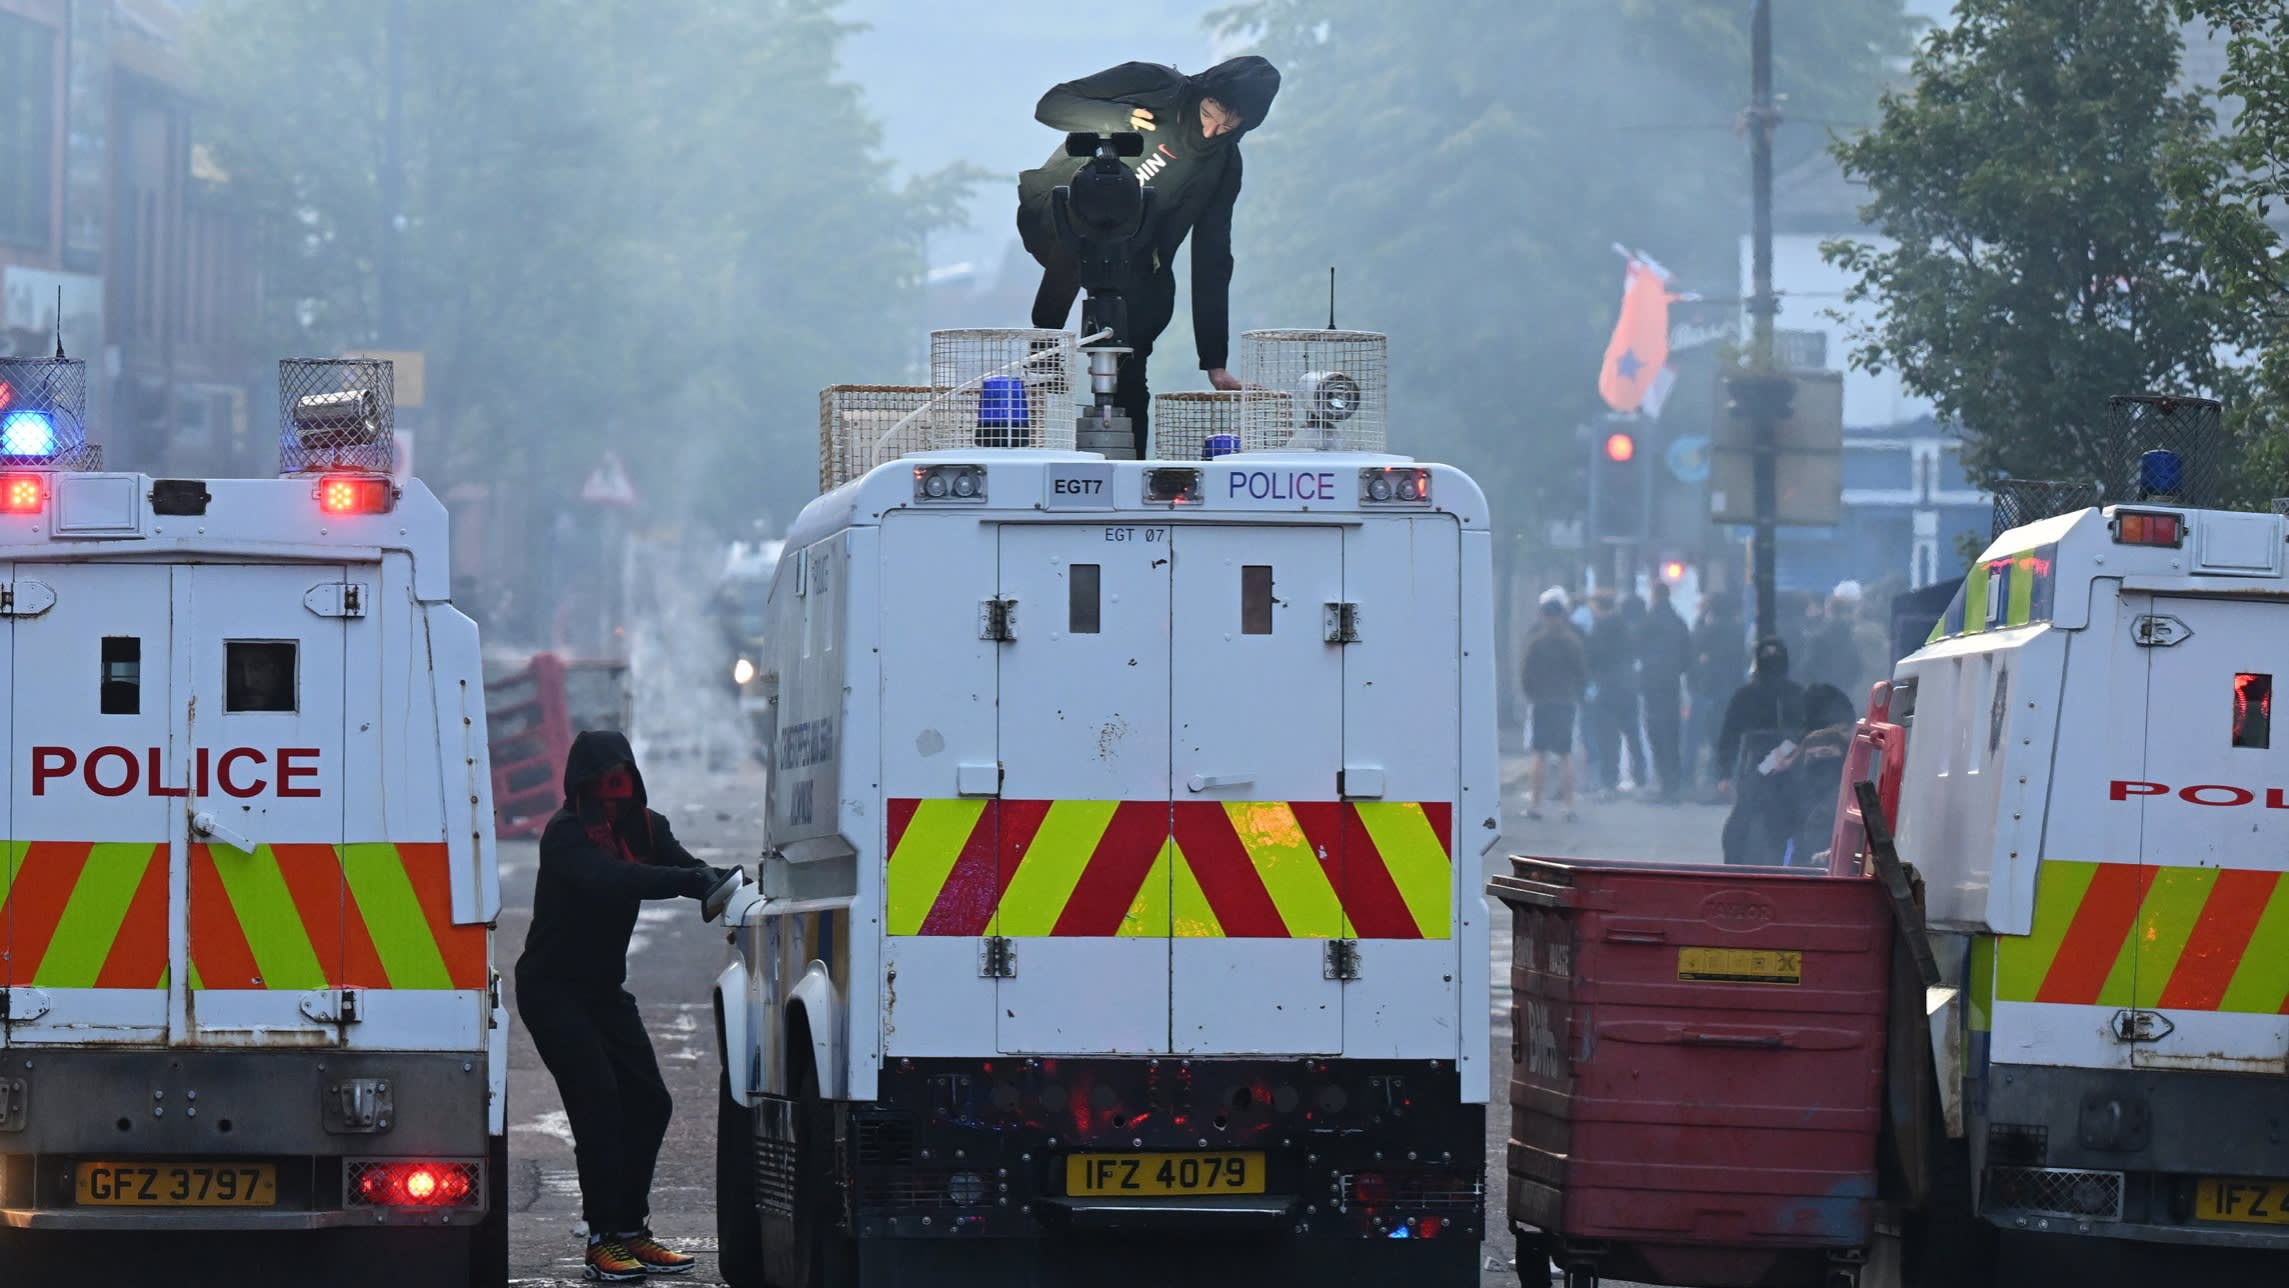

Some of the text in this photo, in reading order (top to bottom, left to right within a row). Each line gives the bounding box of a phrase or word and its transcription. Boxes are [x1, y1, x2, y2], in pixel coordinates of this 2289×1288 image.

[1135, 153, 1167, 187] NIK
[1054, 479, 1104, 495] EGT7
[1229, 471, 1336, 500] POLICE
[1105, 527, 1165, 543] EGT 07
[32, 745, 321, 798] POLICE
[91, 1168, 260, 1200] GFZ 3797
[1086, 1157, 1245, 1189] IFZ 4079
[2215, 1183, 2270, 1217] IFZ
